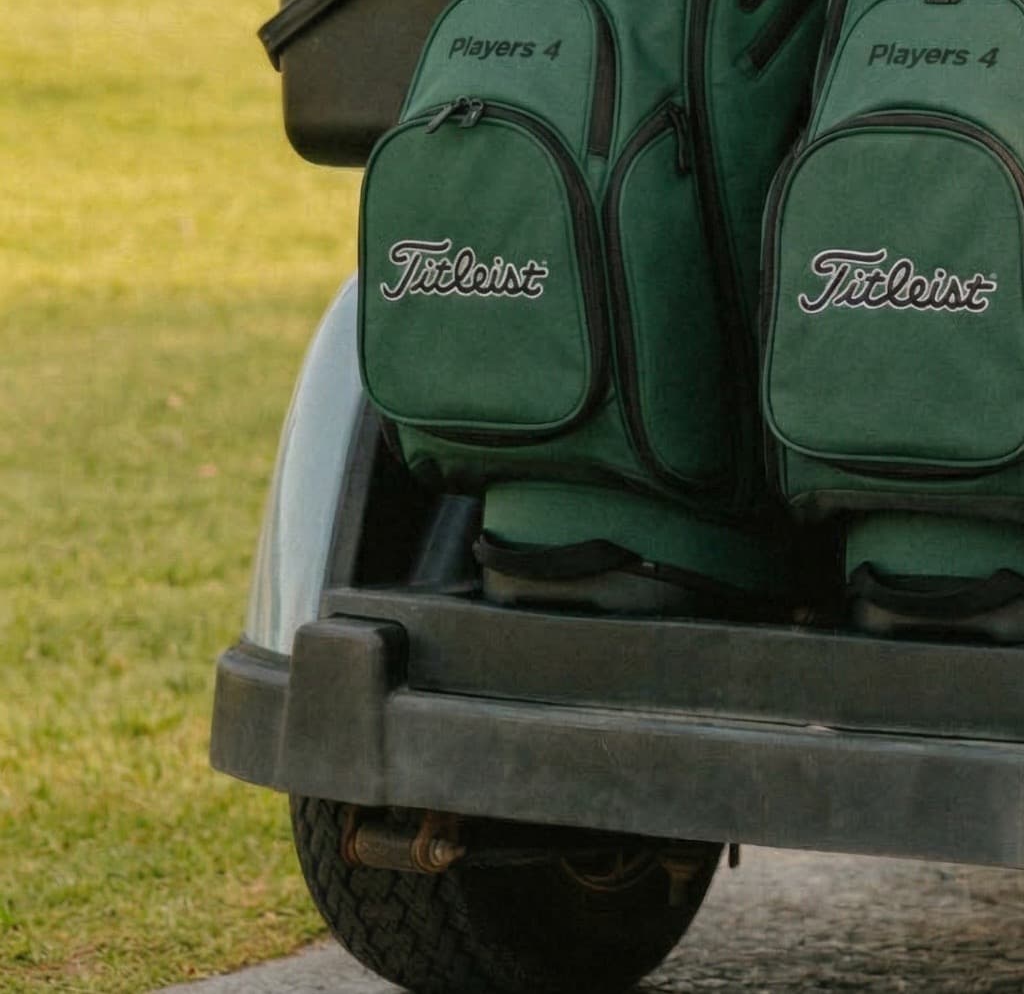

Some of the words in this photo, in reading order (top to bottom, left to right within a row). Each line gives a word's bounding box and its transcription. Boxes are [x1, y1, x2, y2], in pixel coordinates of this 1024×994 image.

[447, 35, 536, 61] Players
[542, 39, 562, 61] 4
[867, 42, 970, 69] Players
[977, 47, 1000, 69] 4
[379, 238, 549, 301] Titleist
[798, 248, 996, 313] Titleist
